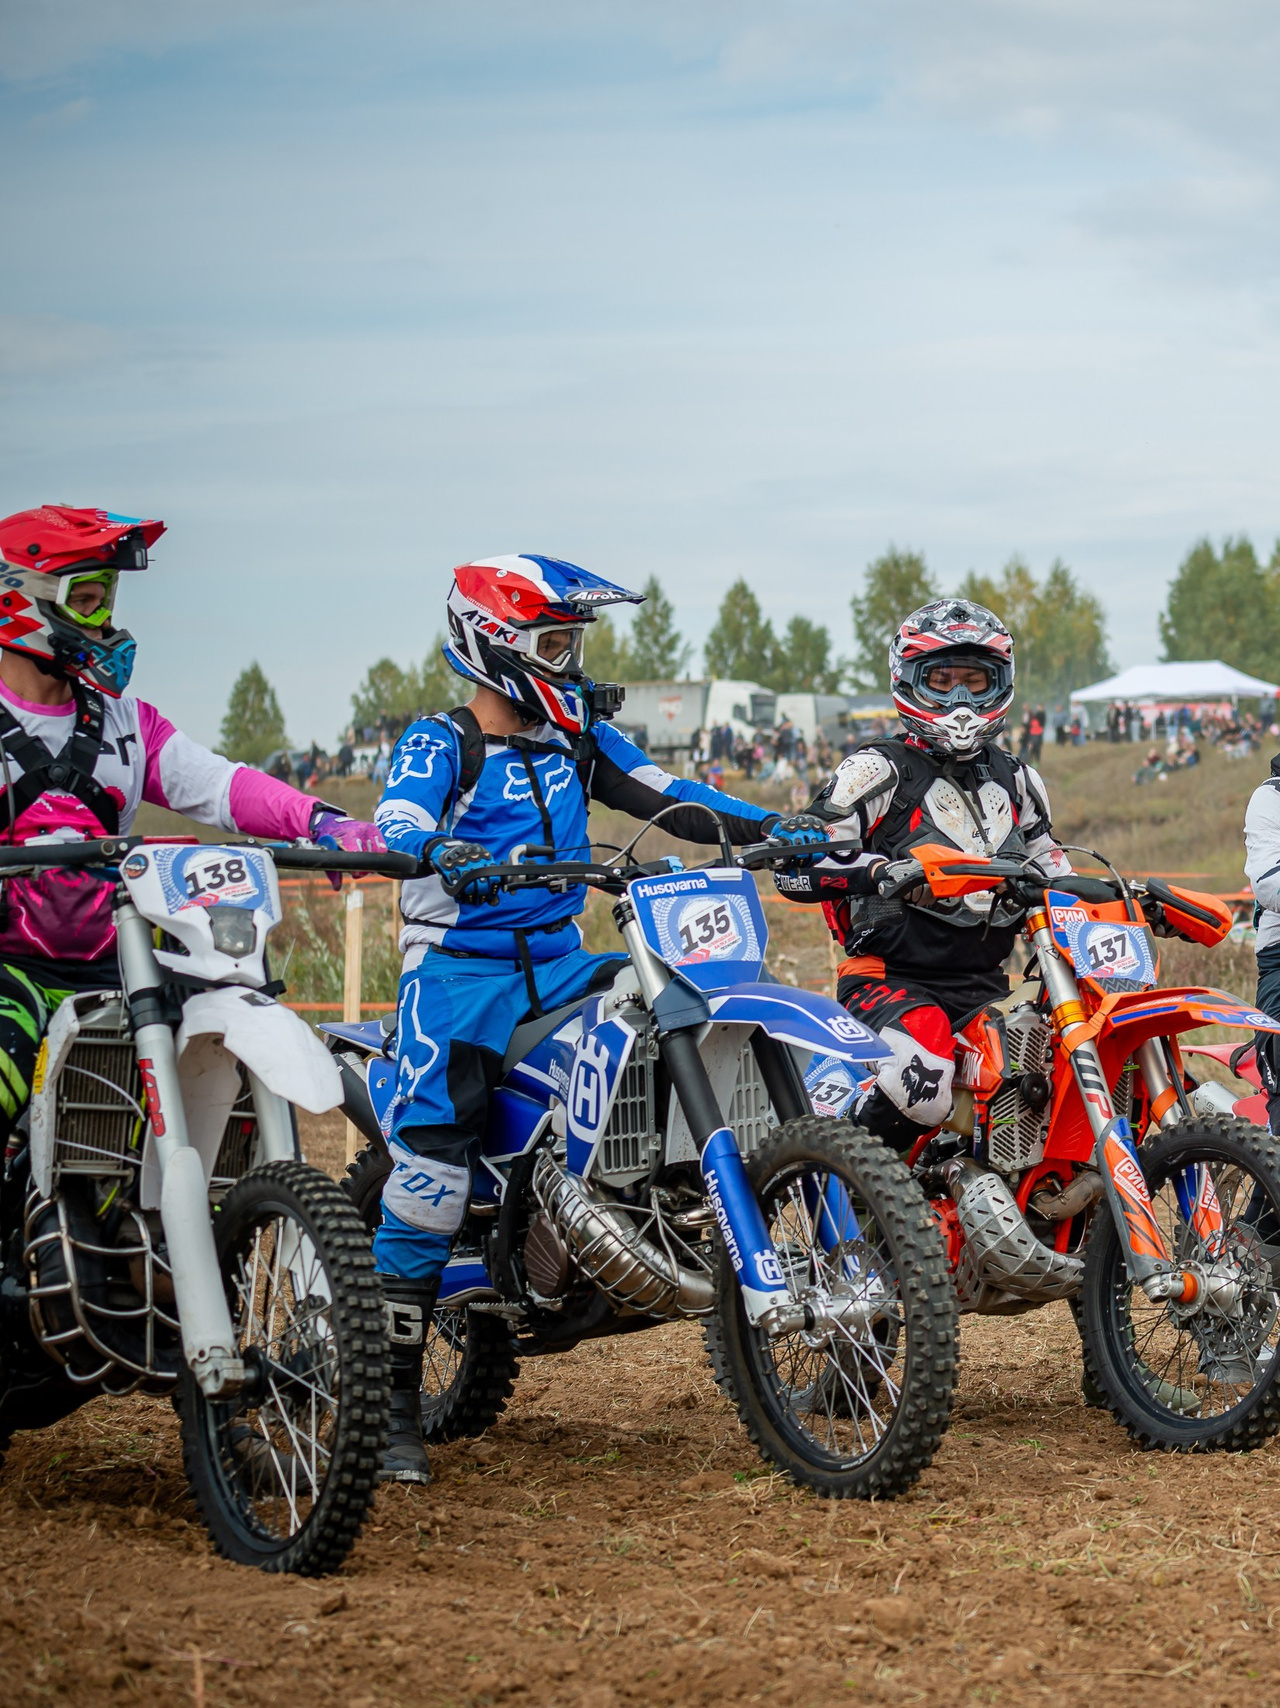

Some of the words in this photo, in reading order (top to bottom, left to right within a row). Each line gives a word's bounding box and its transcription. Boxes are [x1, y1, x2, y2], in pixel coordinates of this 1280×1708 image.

[184, 859, 247, 899] 138
[637, 878, 708, 898] Husqvarna
[679, 904, 731, 955] 135
[1087, 933, 1127, 970] 137
[808, 1081, 852, 1106] 137
[1119, 1160, 1151, 1197] РИМ
[703, 1170, 744, 1273] Husqvarna
